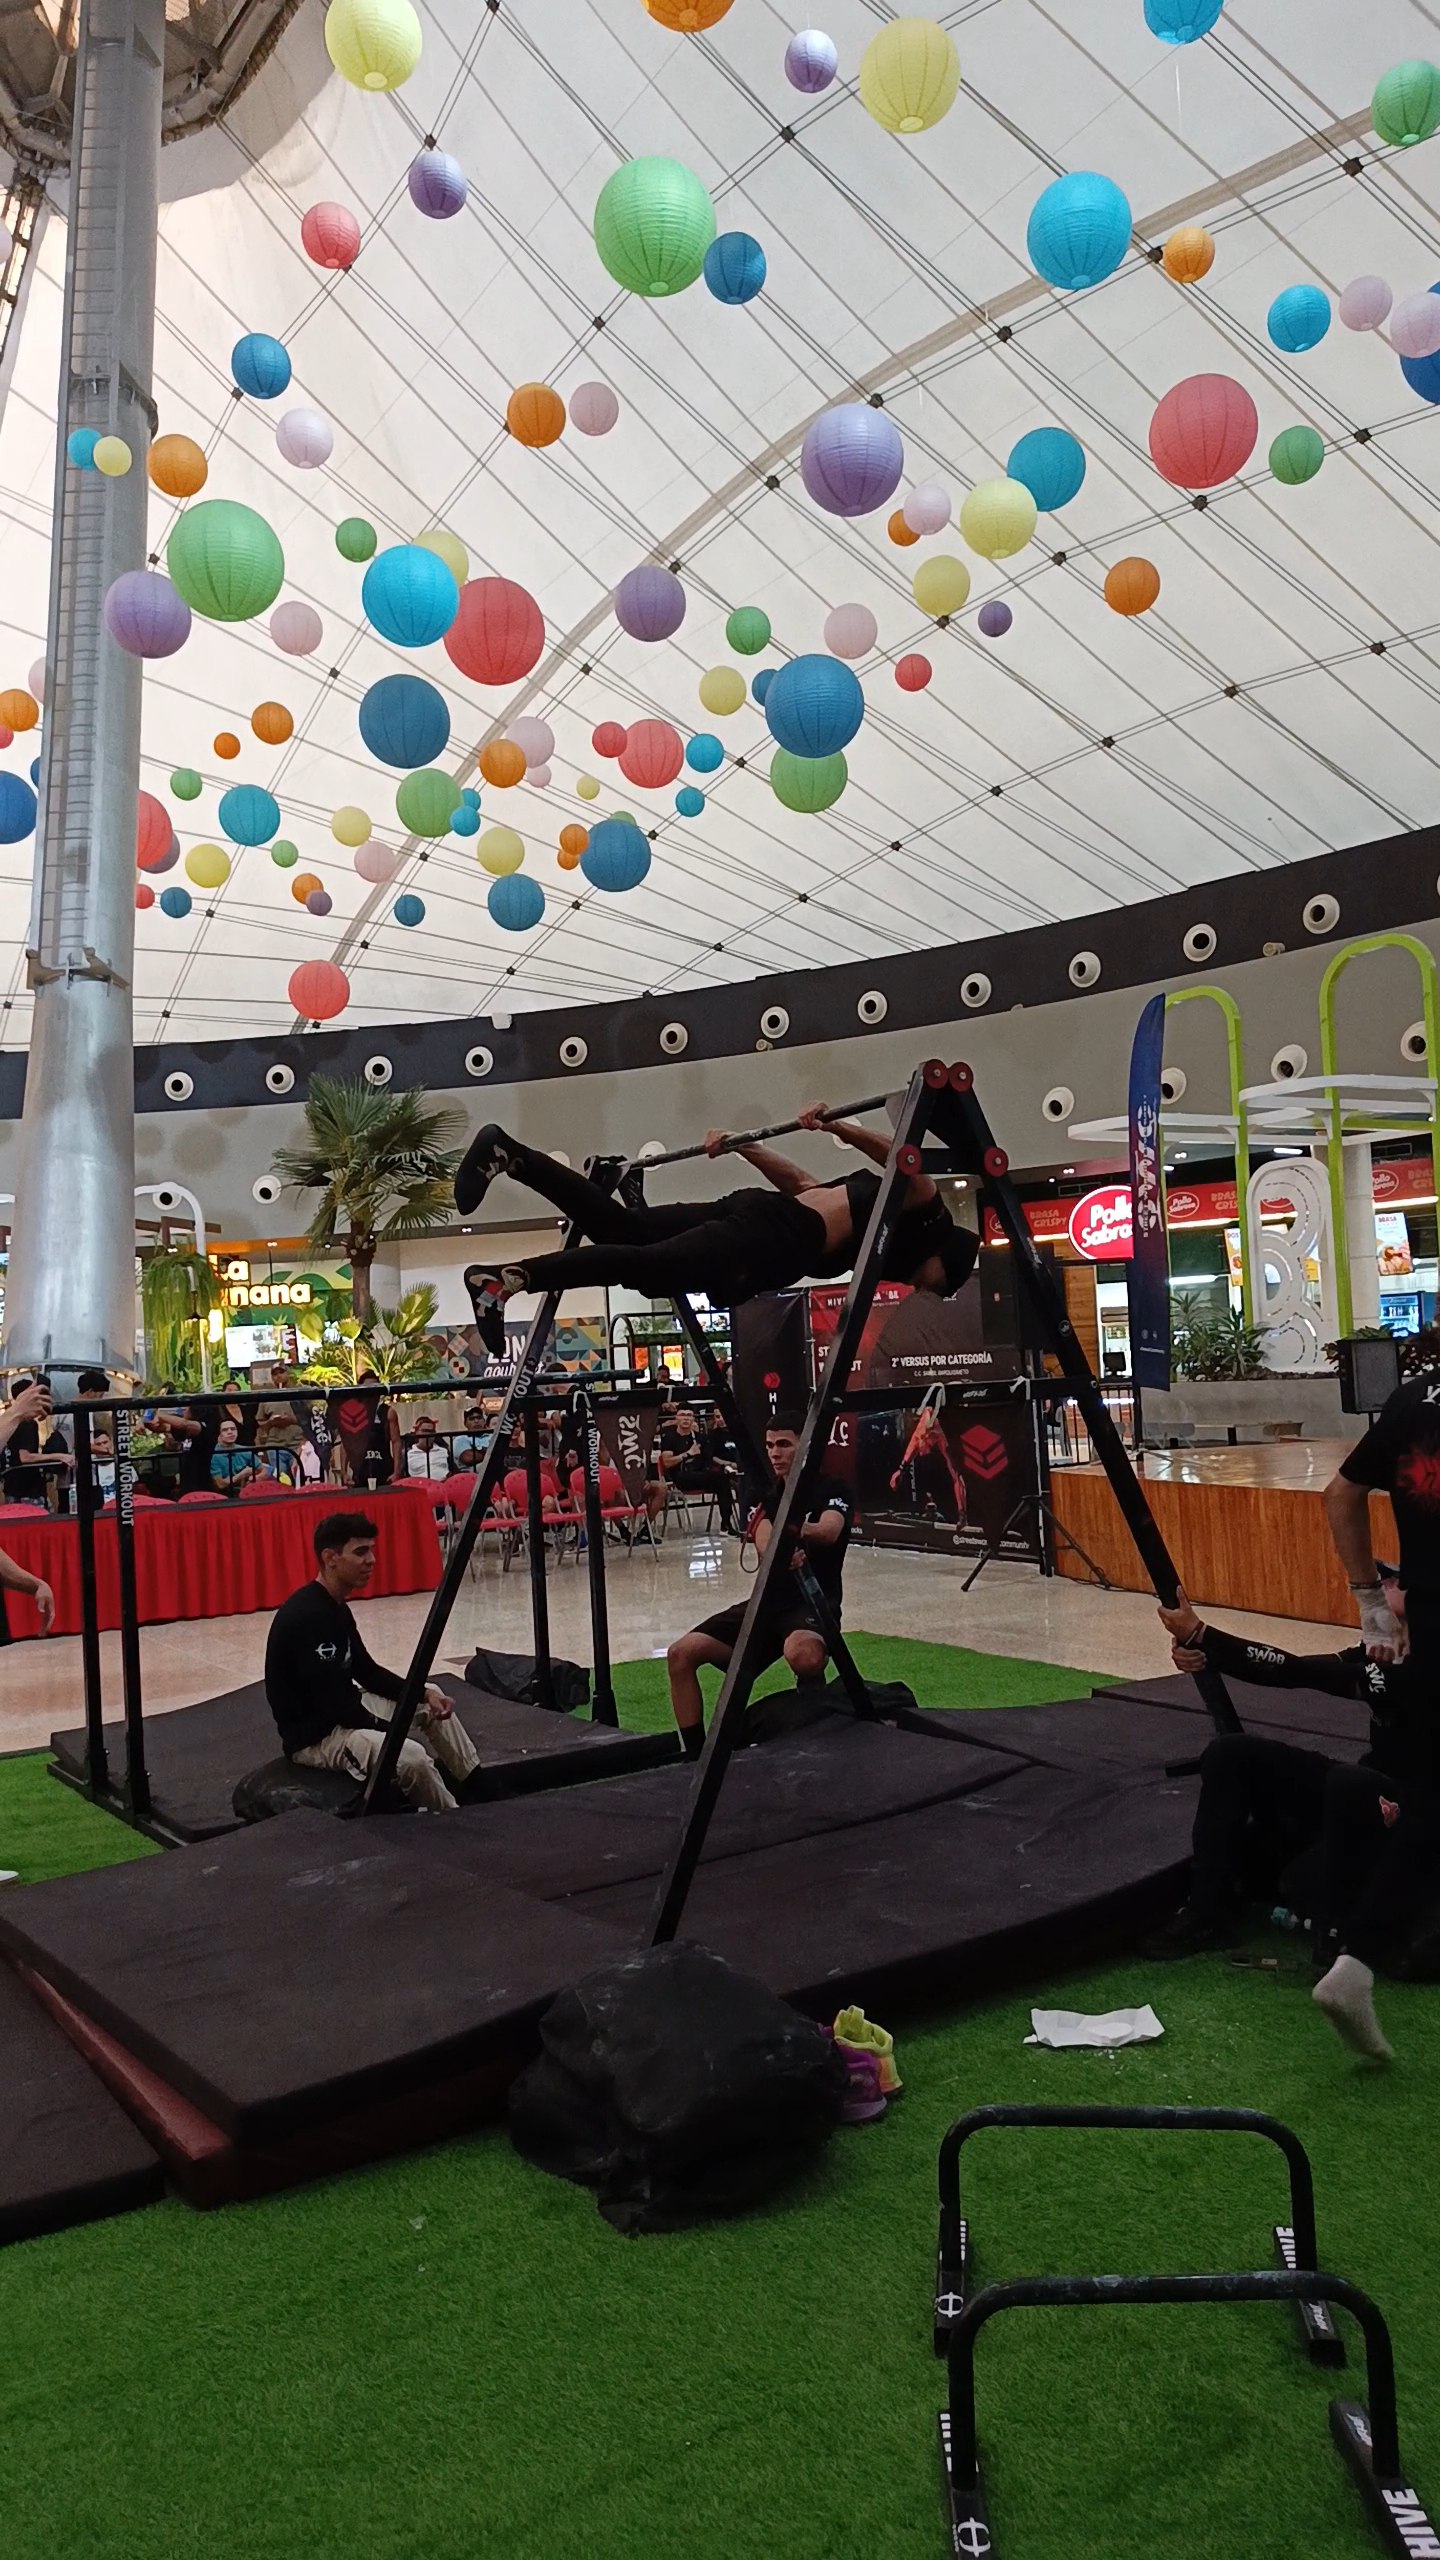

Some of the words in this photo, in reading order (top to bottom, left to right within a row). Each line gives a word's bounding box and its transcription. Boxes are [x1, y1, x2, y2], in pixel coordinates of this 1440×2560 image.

[1030, 1209, 1059, 1219] BRASA
[1034, 1217, 1067, 1228] CRISPY
[900, 1356, 929, 1367] VERSUS
[931, 1355, 946, 1365] POR
[948, 1351, 992, 1364] CATEGORÍA
[116, 1409, 131, 1458] STREET
[588, 1427, 600, 1484] WORKOUT
[119, 1461, 134, 1526] WORKOUT
[1381, 2488, 1440, 2560] HIVE
